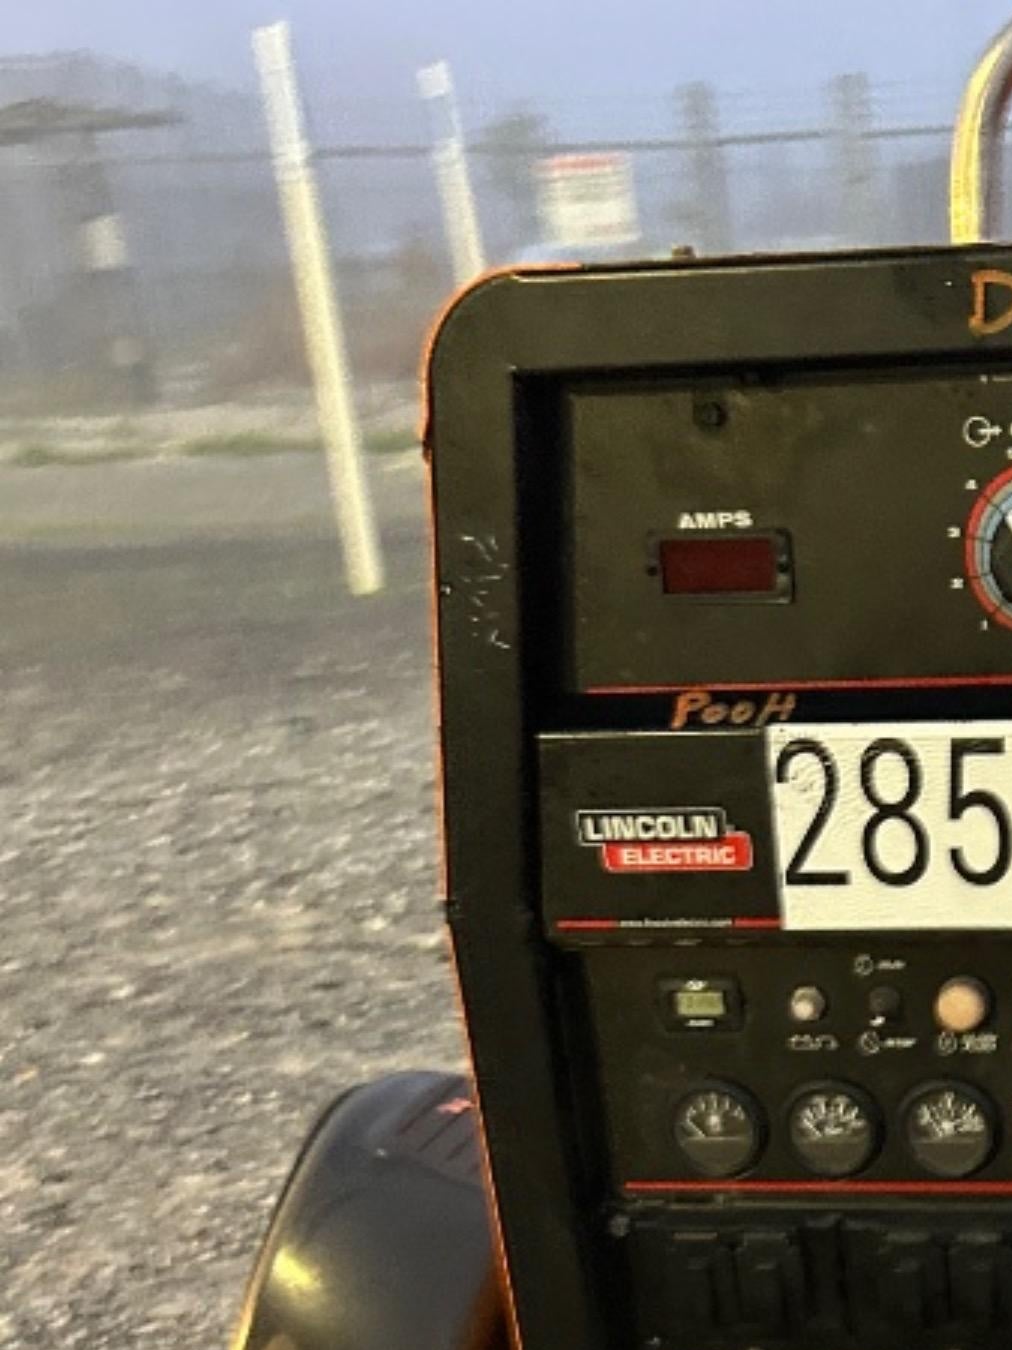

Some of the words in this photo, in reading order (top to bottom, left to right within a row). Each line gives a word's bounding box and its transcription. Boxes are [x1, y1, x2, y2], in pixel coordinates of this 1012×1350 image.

[678, 510, 753, 529] AMPS
[584, 814, 718, 841] LINCOLN
[621, 845, 737, 866] ELECTRIC
